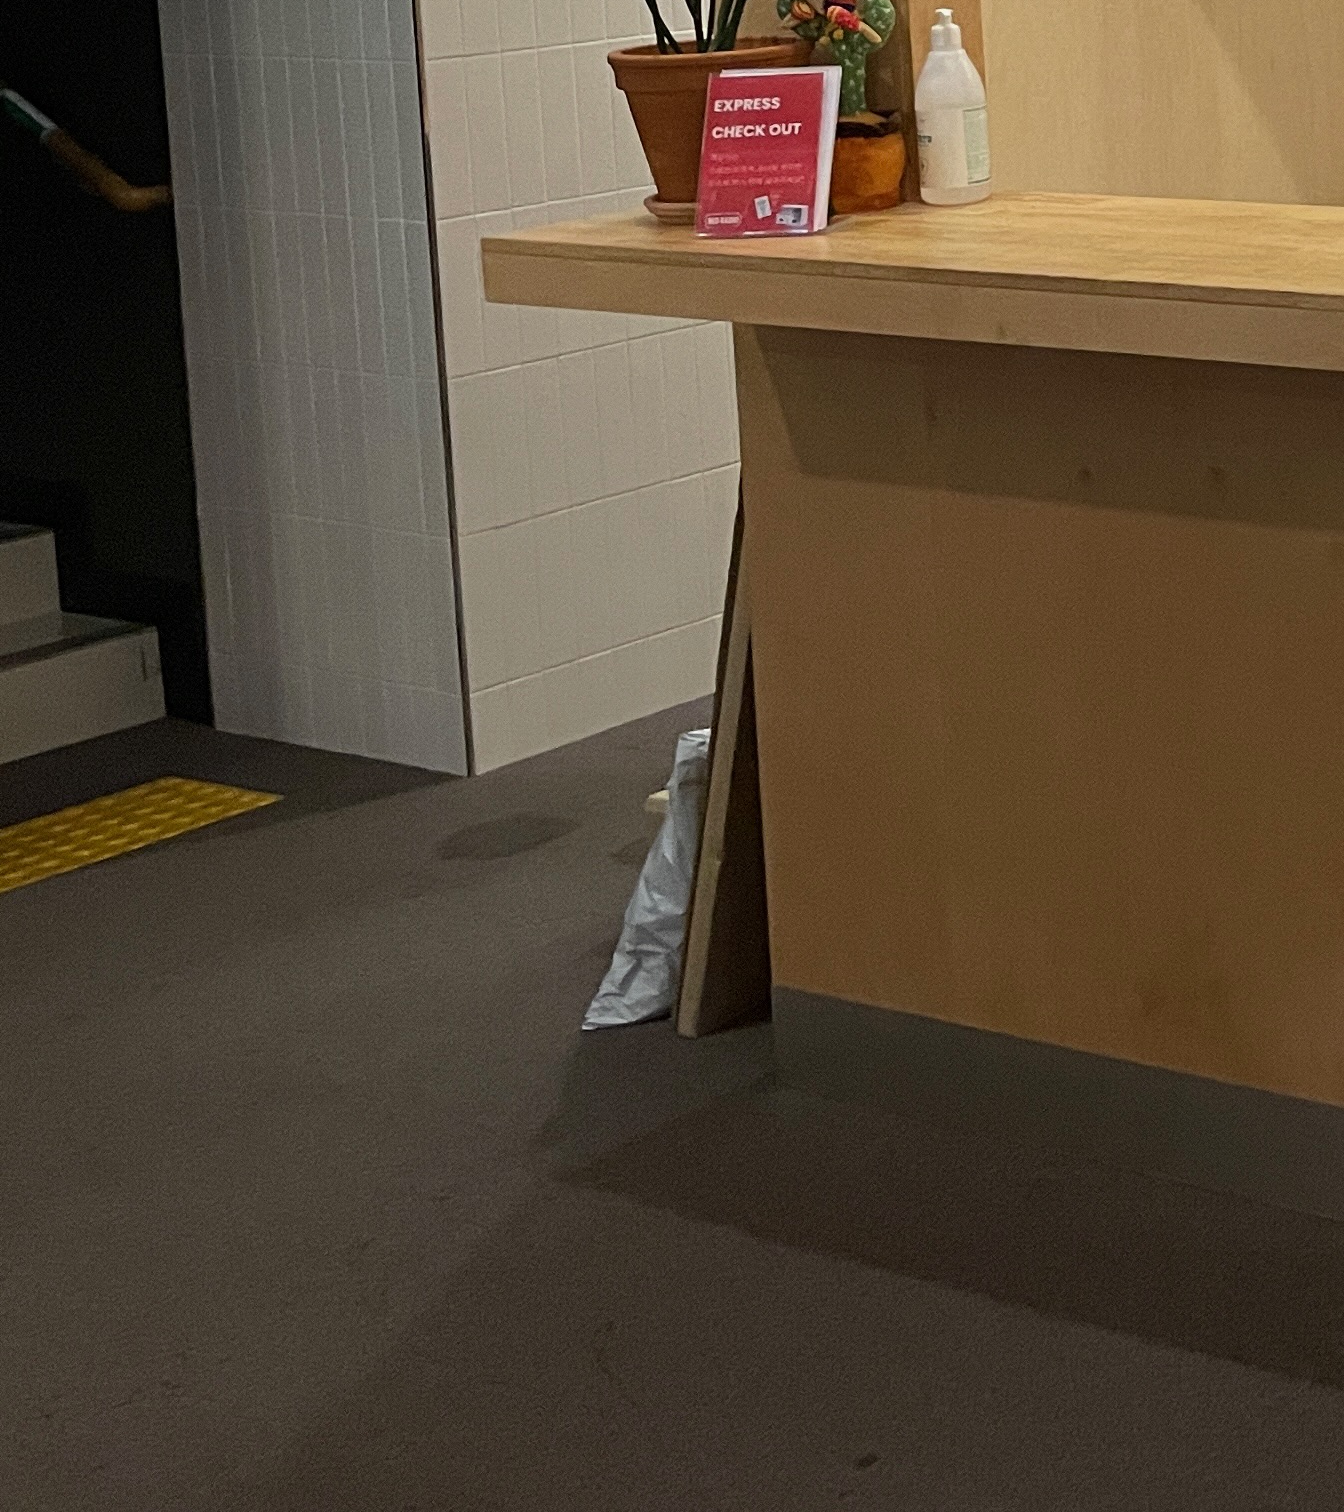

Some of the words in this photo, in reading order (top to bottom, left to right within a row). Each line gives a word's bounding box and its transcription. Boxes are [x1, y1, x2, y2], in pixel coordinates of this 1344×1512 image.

[714, 97, 781, 113] EXPRESS
[712, 123, 766, 139] CHECK
[769, 122, 802, 136] OUT
